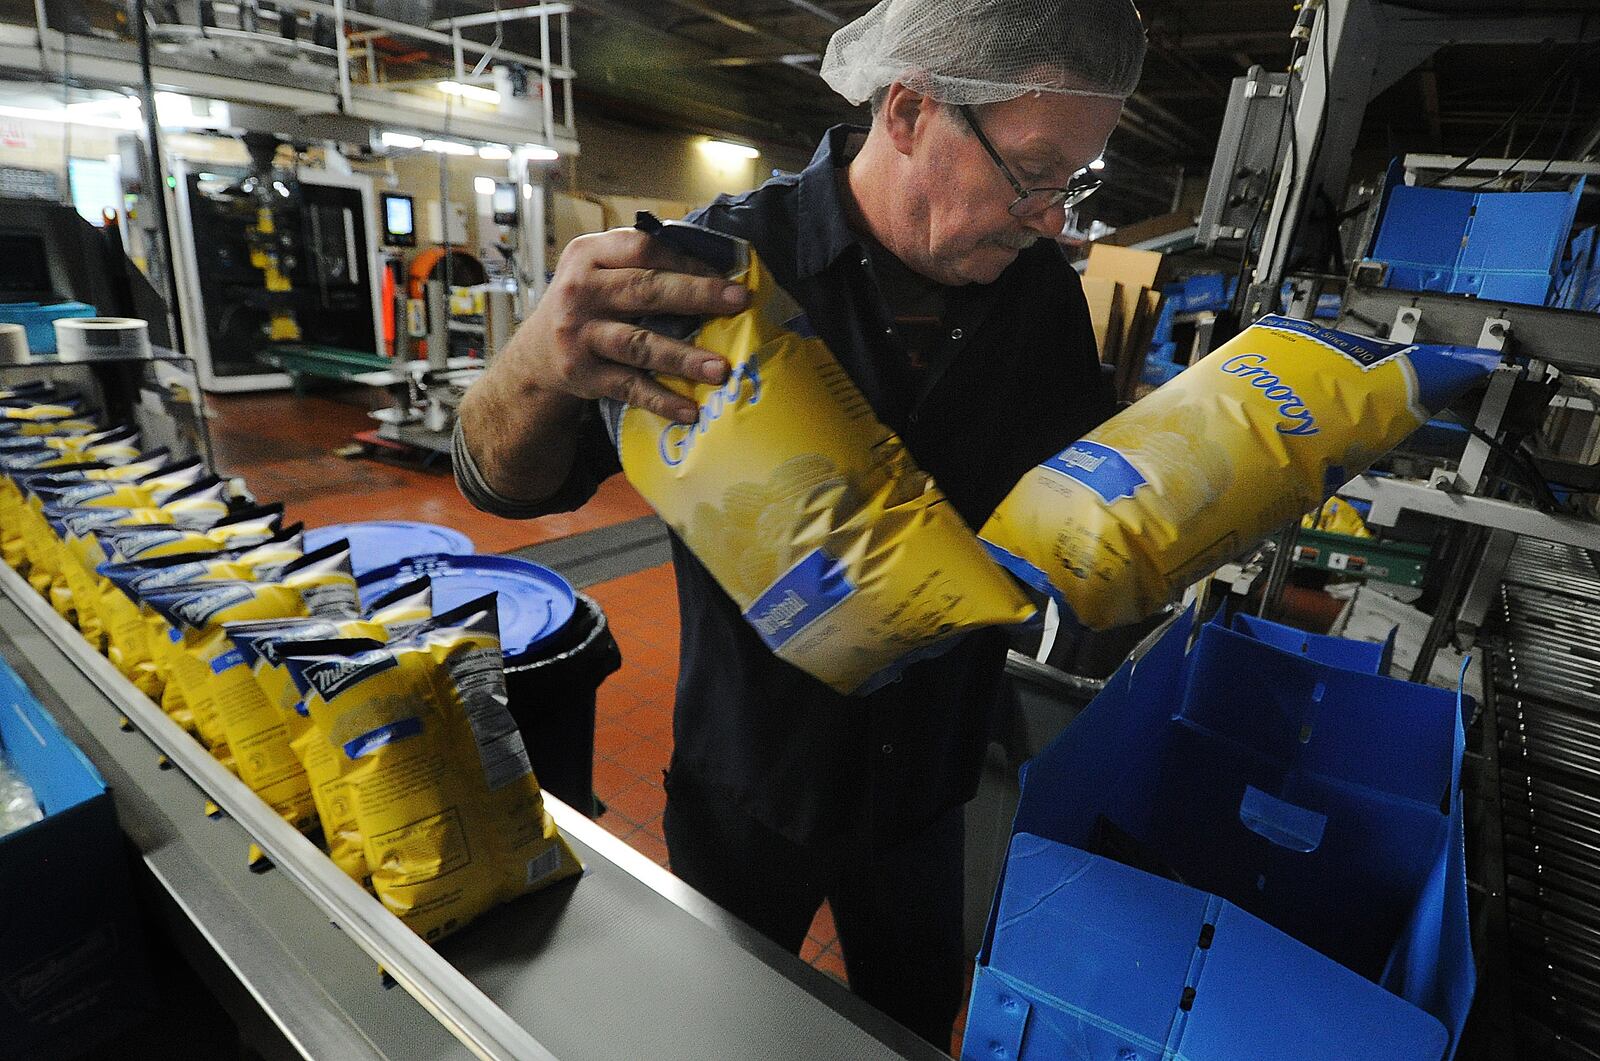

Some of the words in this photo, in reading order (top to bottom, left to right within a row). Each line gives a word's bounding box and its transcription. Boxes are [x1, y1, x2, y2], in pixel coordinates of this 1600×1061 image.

[1320, 331, 1348, 349] Since
[1349, 345, 1375, 362] 1910
[1219, 353, 1320, 436] Groovy
